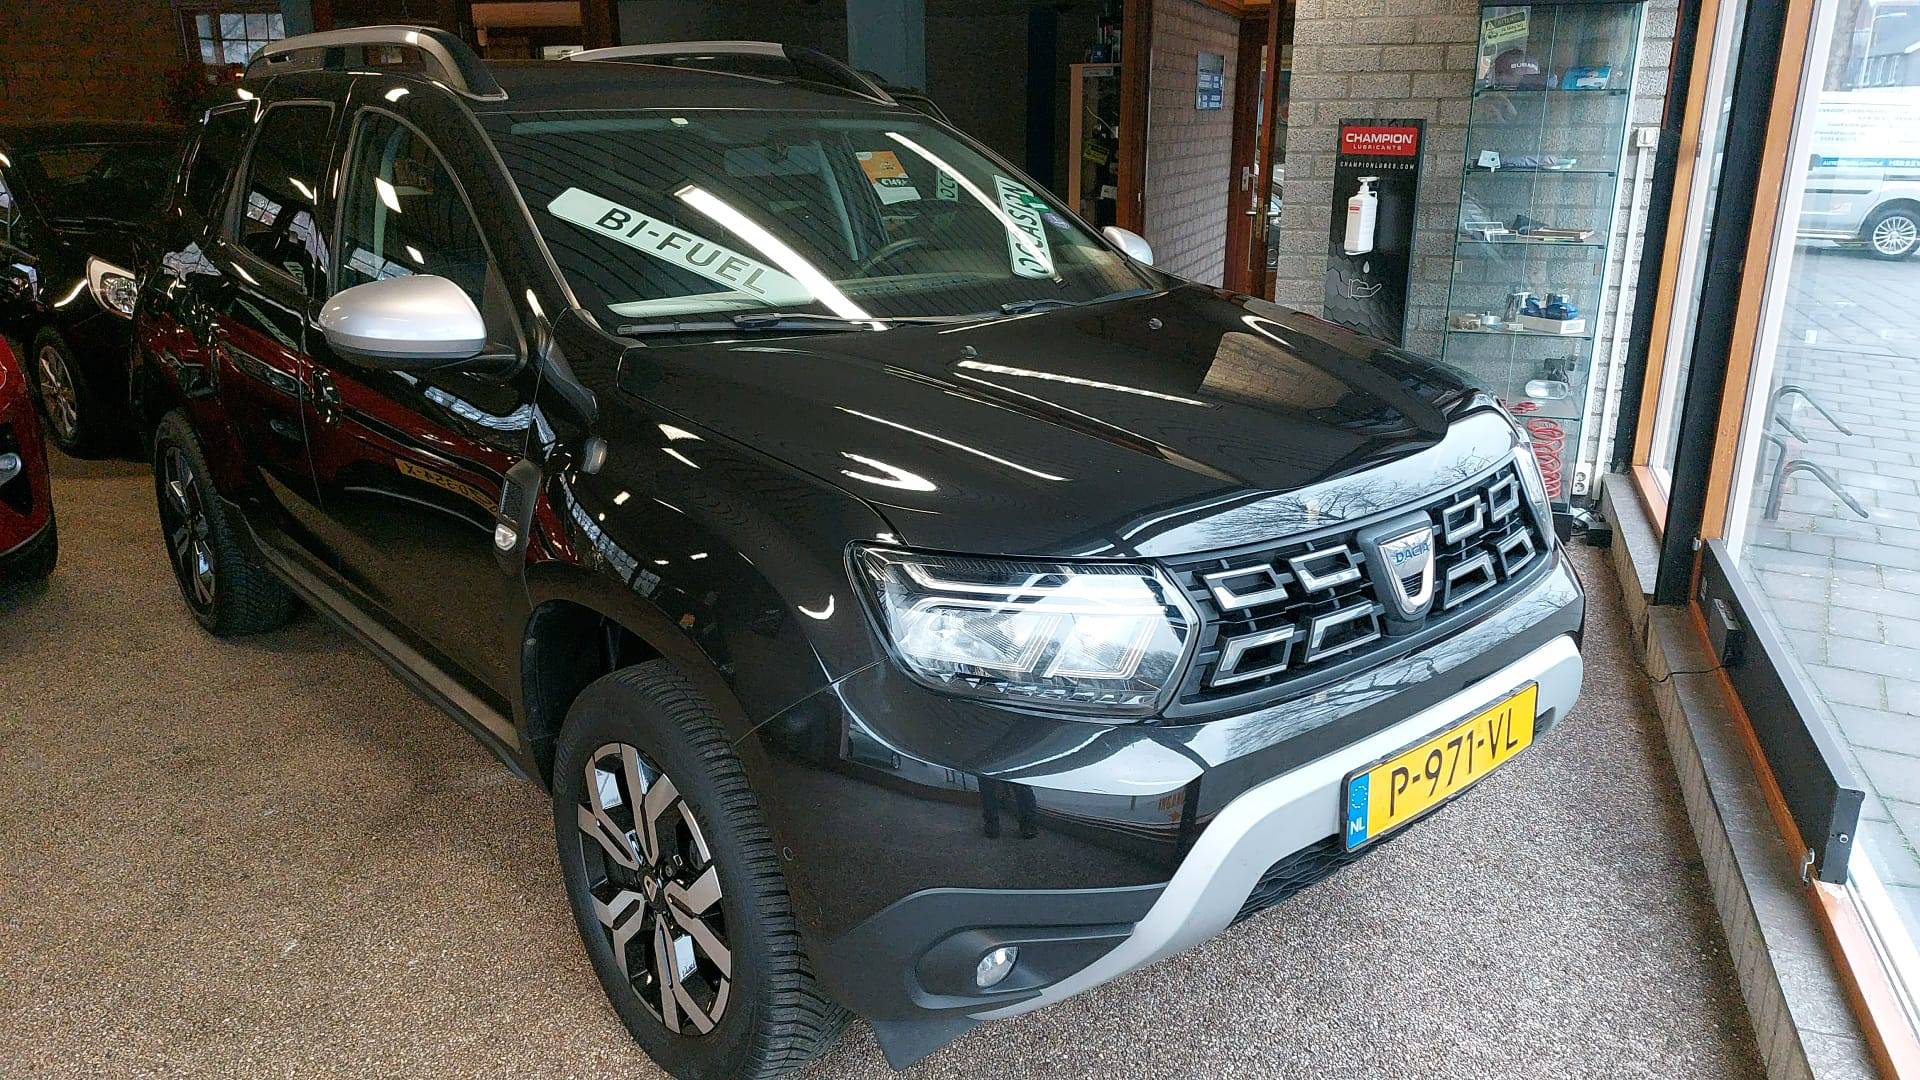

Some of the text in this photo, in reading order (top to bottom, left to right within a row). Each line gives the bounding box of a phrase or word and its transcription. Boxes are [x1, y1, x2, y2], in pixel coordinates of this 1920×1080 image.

[1345, 133, 1413, 144] CHAMPION
[595, 207, 768, 295] BI-FUEL
[1000, 180, 1050, 274] OCASION
[1394, 542, 1431, 564] DACIA
[1389, 708, 1519, 818] P-971-VL
[1350, 821, 1366, 836] NL
